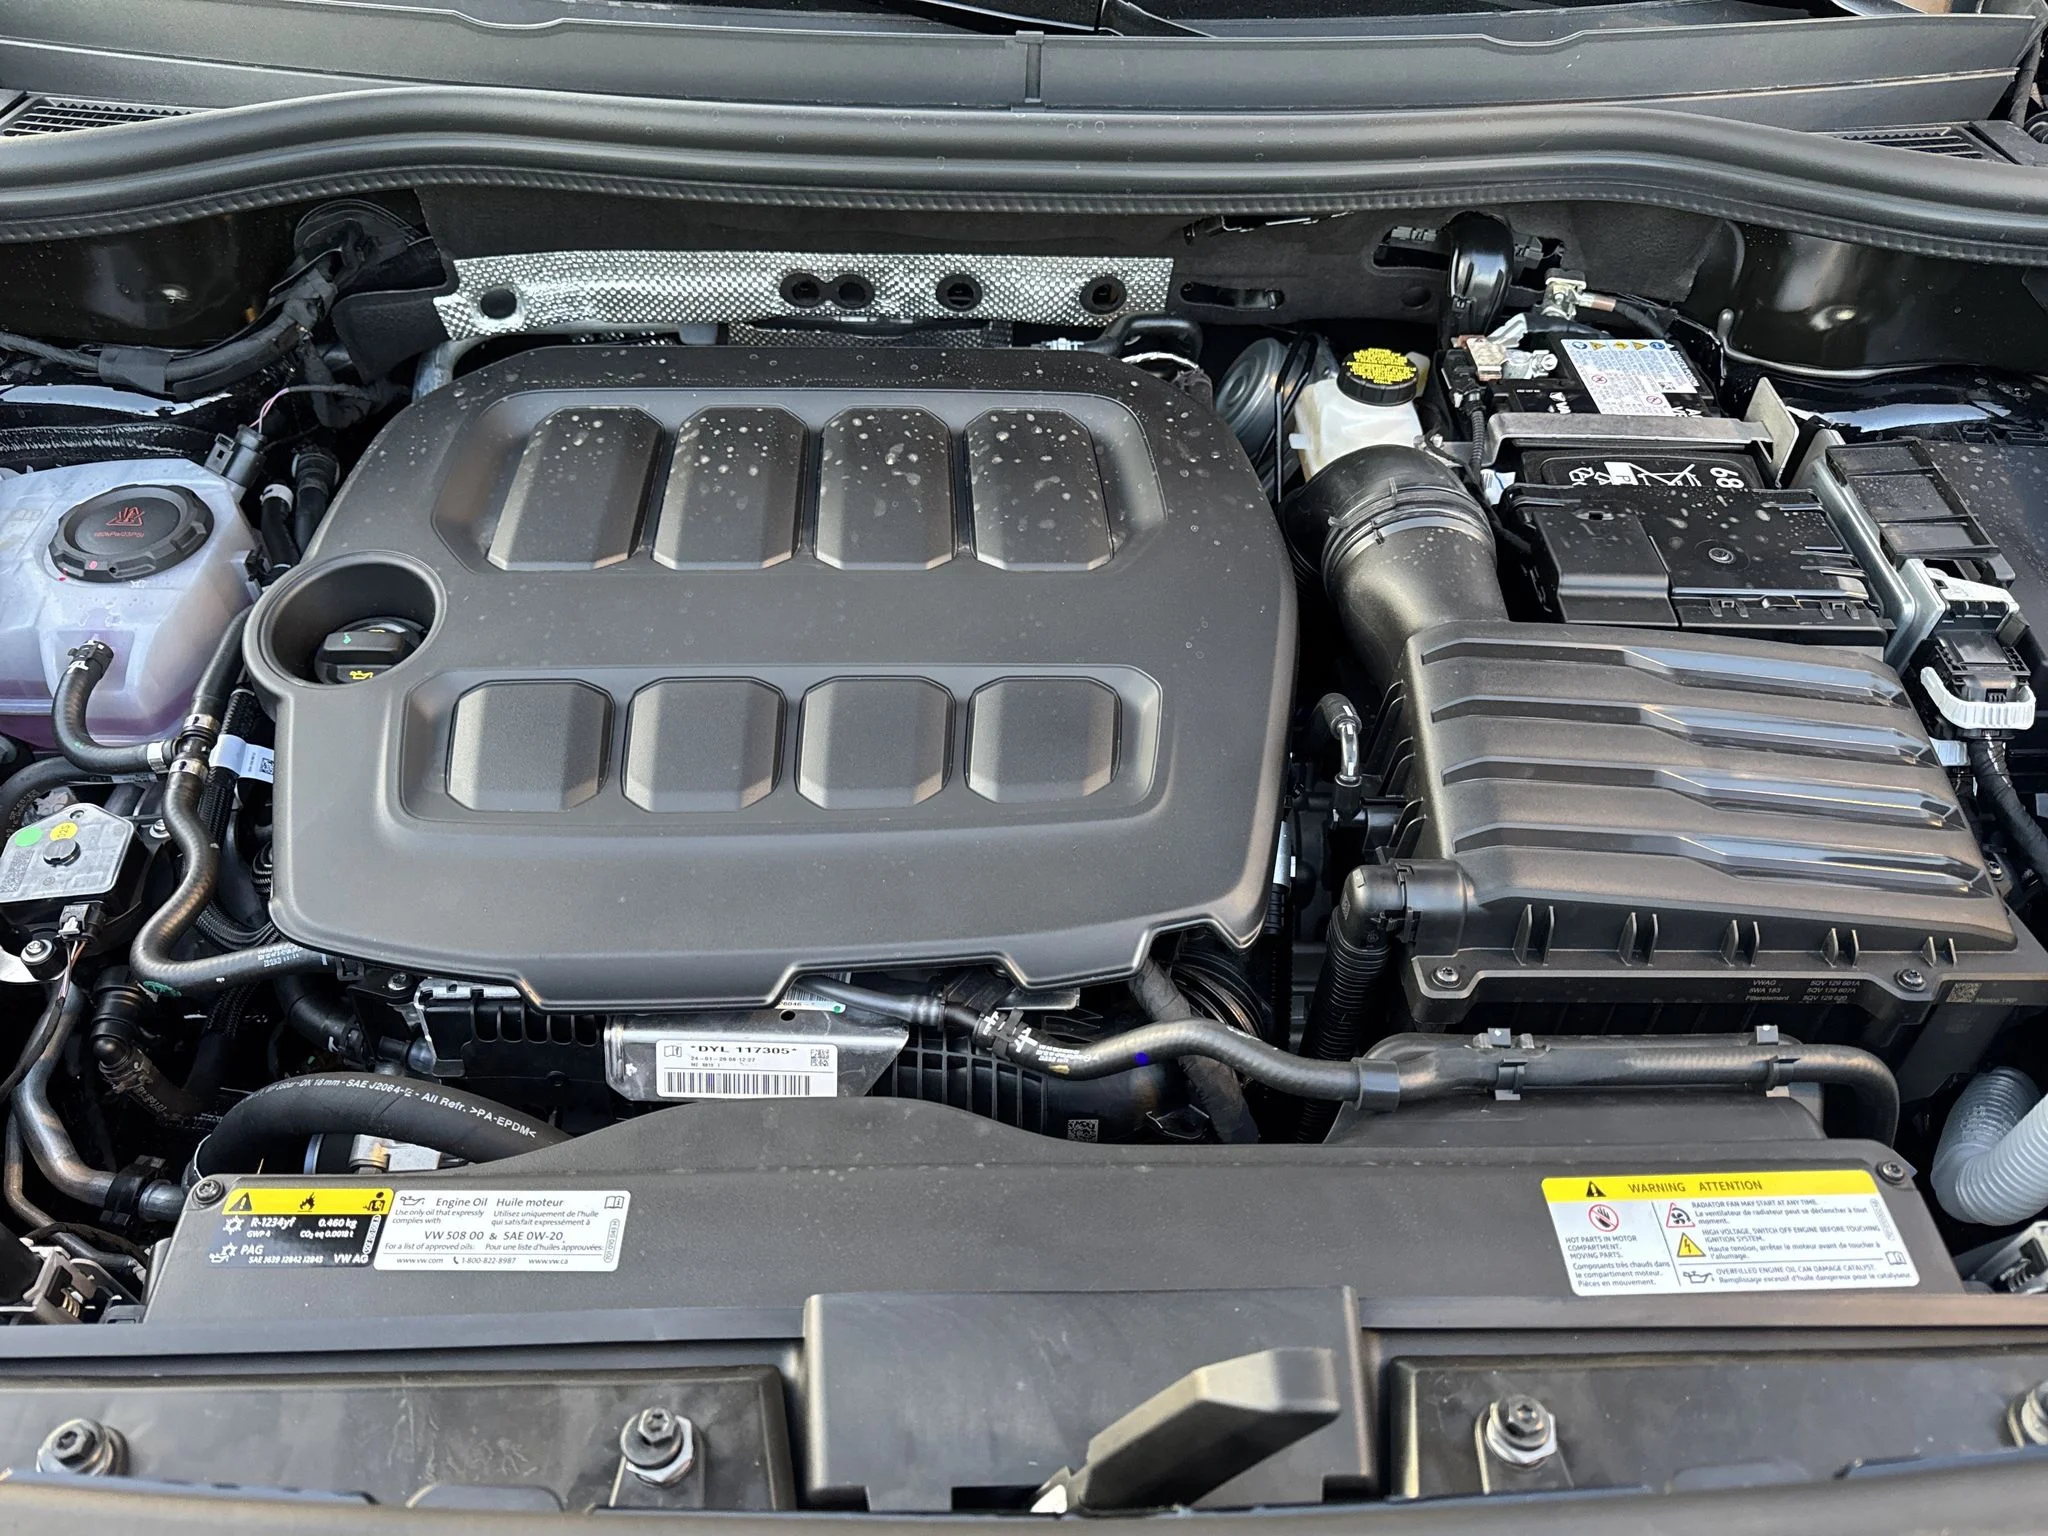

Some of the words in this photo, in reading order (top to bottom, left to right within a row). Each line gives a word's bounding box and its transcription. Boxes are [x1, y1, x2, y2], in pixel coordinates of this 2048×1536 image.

[346, 1079, 367, 1089] SAE
[421, 1092, 439, 1104] All
[1628, 1183, 1685, 1193] WARNING
[1699, 1181, 1761, 1192] ATTENTION
[436, 1198, 473, 1208] Engine
[474, 1198, 487, 1206] Oil
[497, 1198, 524, 1206] Huile
[526, 1199, 564, 1207] moteur
[452, 1209, 484, 1218] expressly
[521, 1211, 565, 1219] uniquement
[250, 1217, 296, 1229] R-1234yf
[318, 1219, 345, 1228] 0.460
[345, 1218, 357, 1229] kg
[392, 1217, 422, 1225] complies
[534, 1219, 583, 1227] expressément
[424, 1231, 444, 1240] VW
[446, 1231, 466, 1240] 508
[469, 1231, 484, 1240] 00
[489, 1232, 497, 1240] &
[504, 1232, 524, 1240] SAE
[240, 1245, 264, 1255] PAG
[425, 1243, 457, 1251] approved
[249, 1256, 262, 1264] SAE
[334, 1254, 352, 1263] VW
[353, 1254, 368, 1264] AG
[461, 1257, 516, 1265] 1-800-822-8987
[1573, 1262, 1615, 1270] Composants
[1584, 1270, 1633, 1279] compartiment
[1719, 1276, 1763, 1285] Remplissage
[1764, 1275, 1789, 1283] excessif
